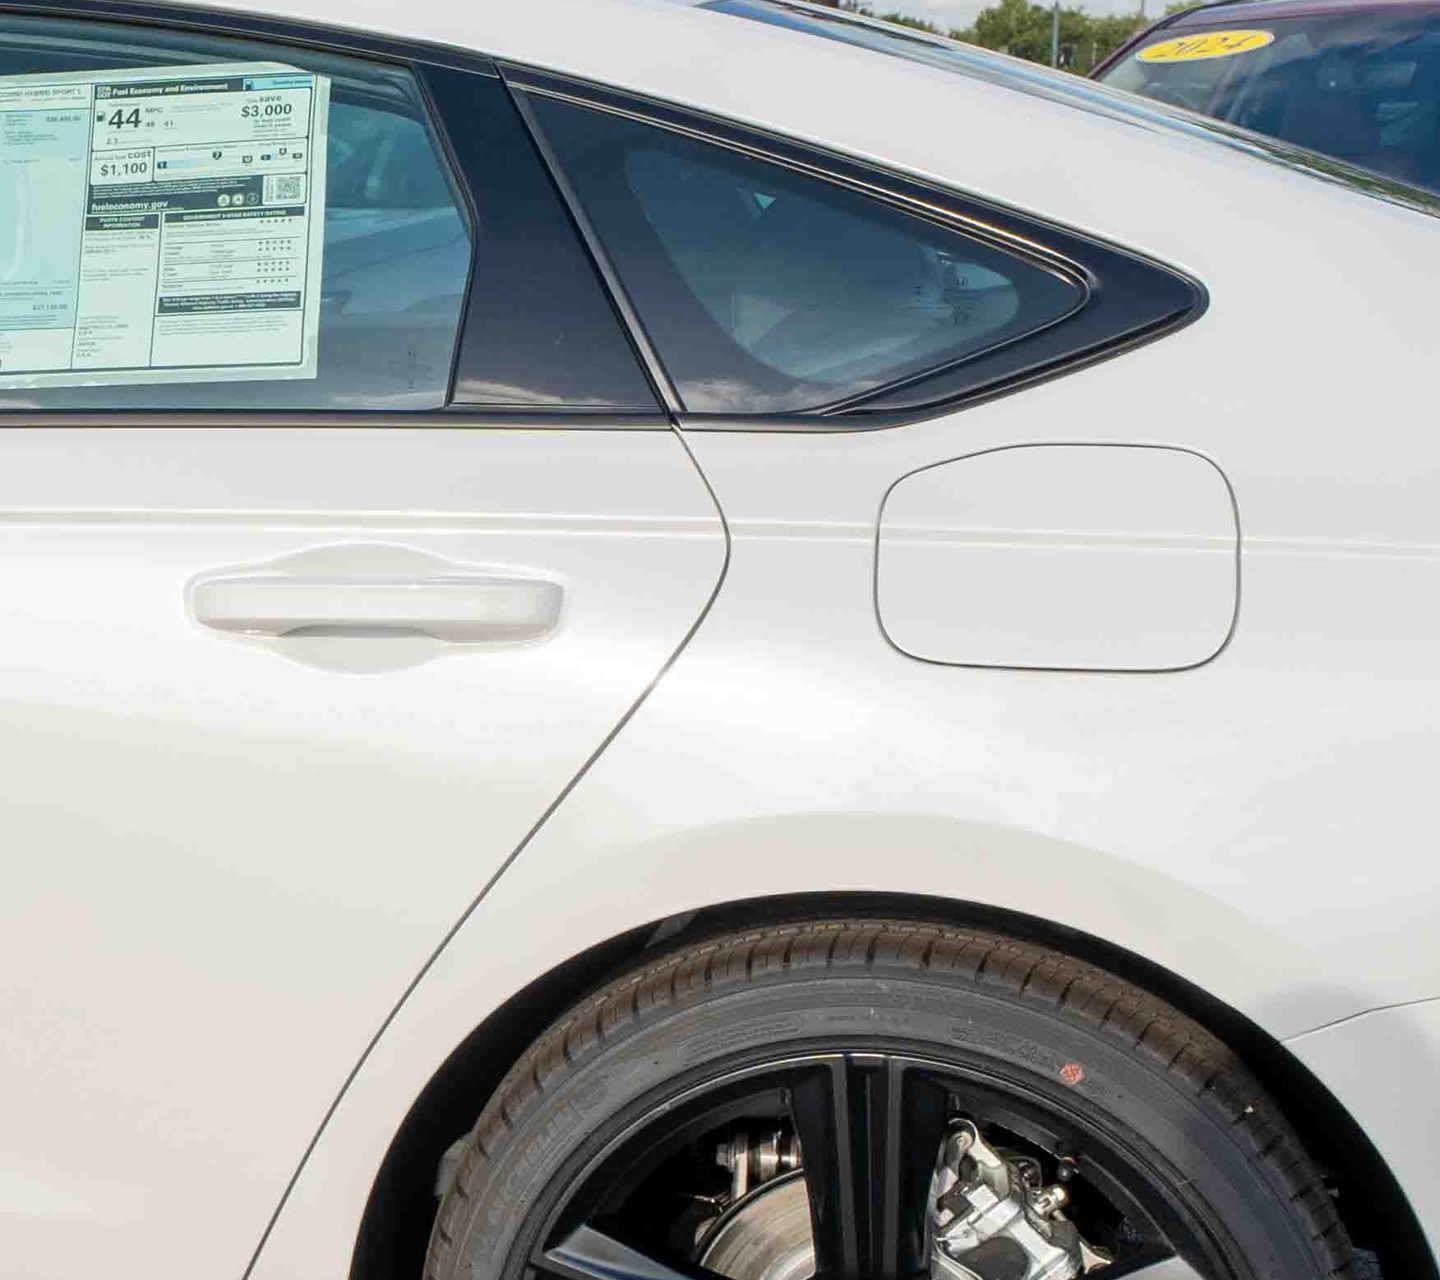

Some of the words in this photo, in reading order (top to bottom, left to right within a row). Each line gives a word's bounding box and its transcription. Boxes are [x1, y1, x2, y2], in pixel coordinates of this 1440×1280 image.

[108, 108, 142, 129] 44
[240, 103, 293, 119] $3,000
[100, 161, 148, 177] $1,100
